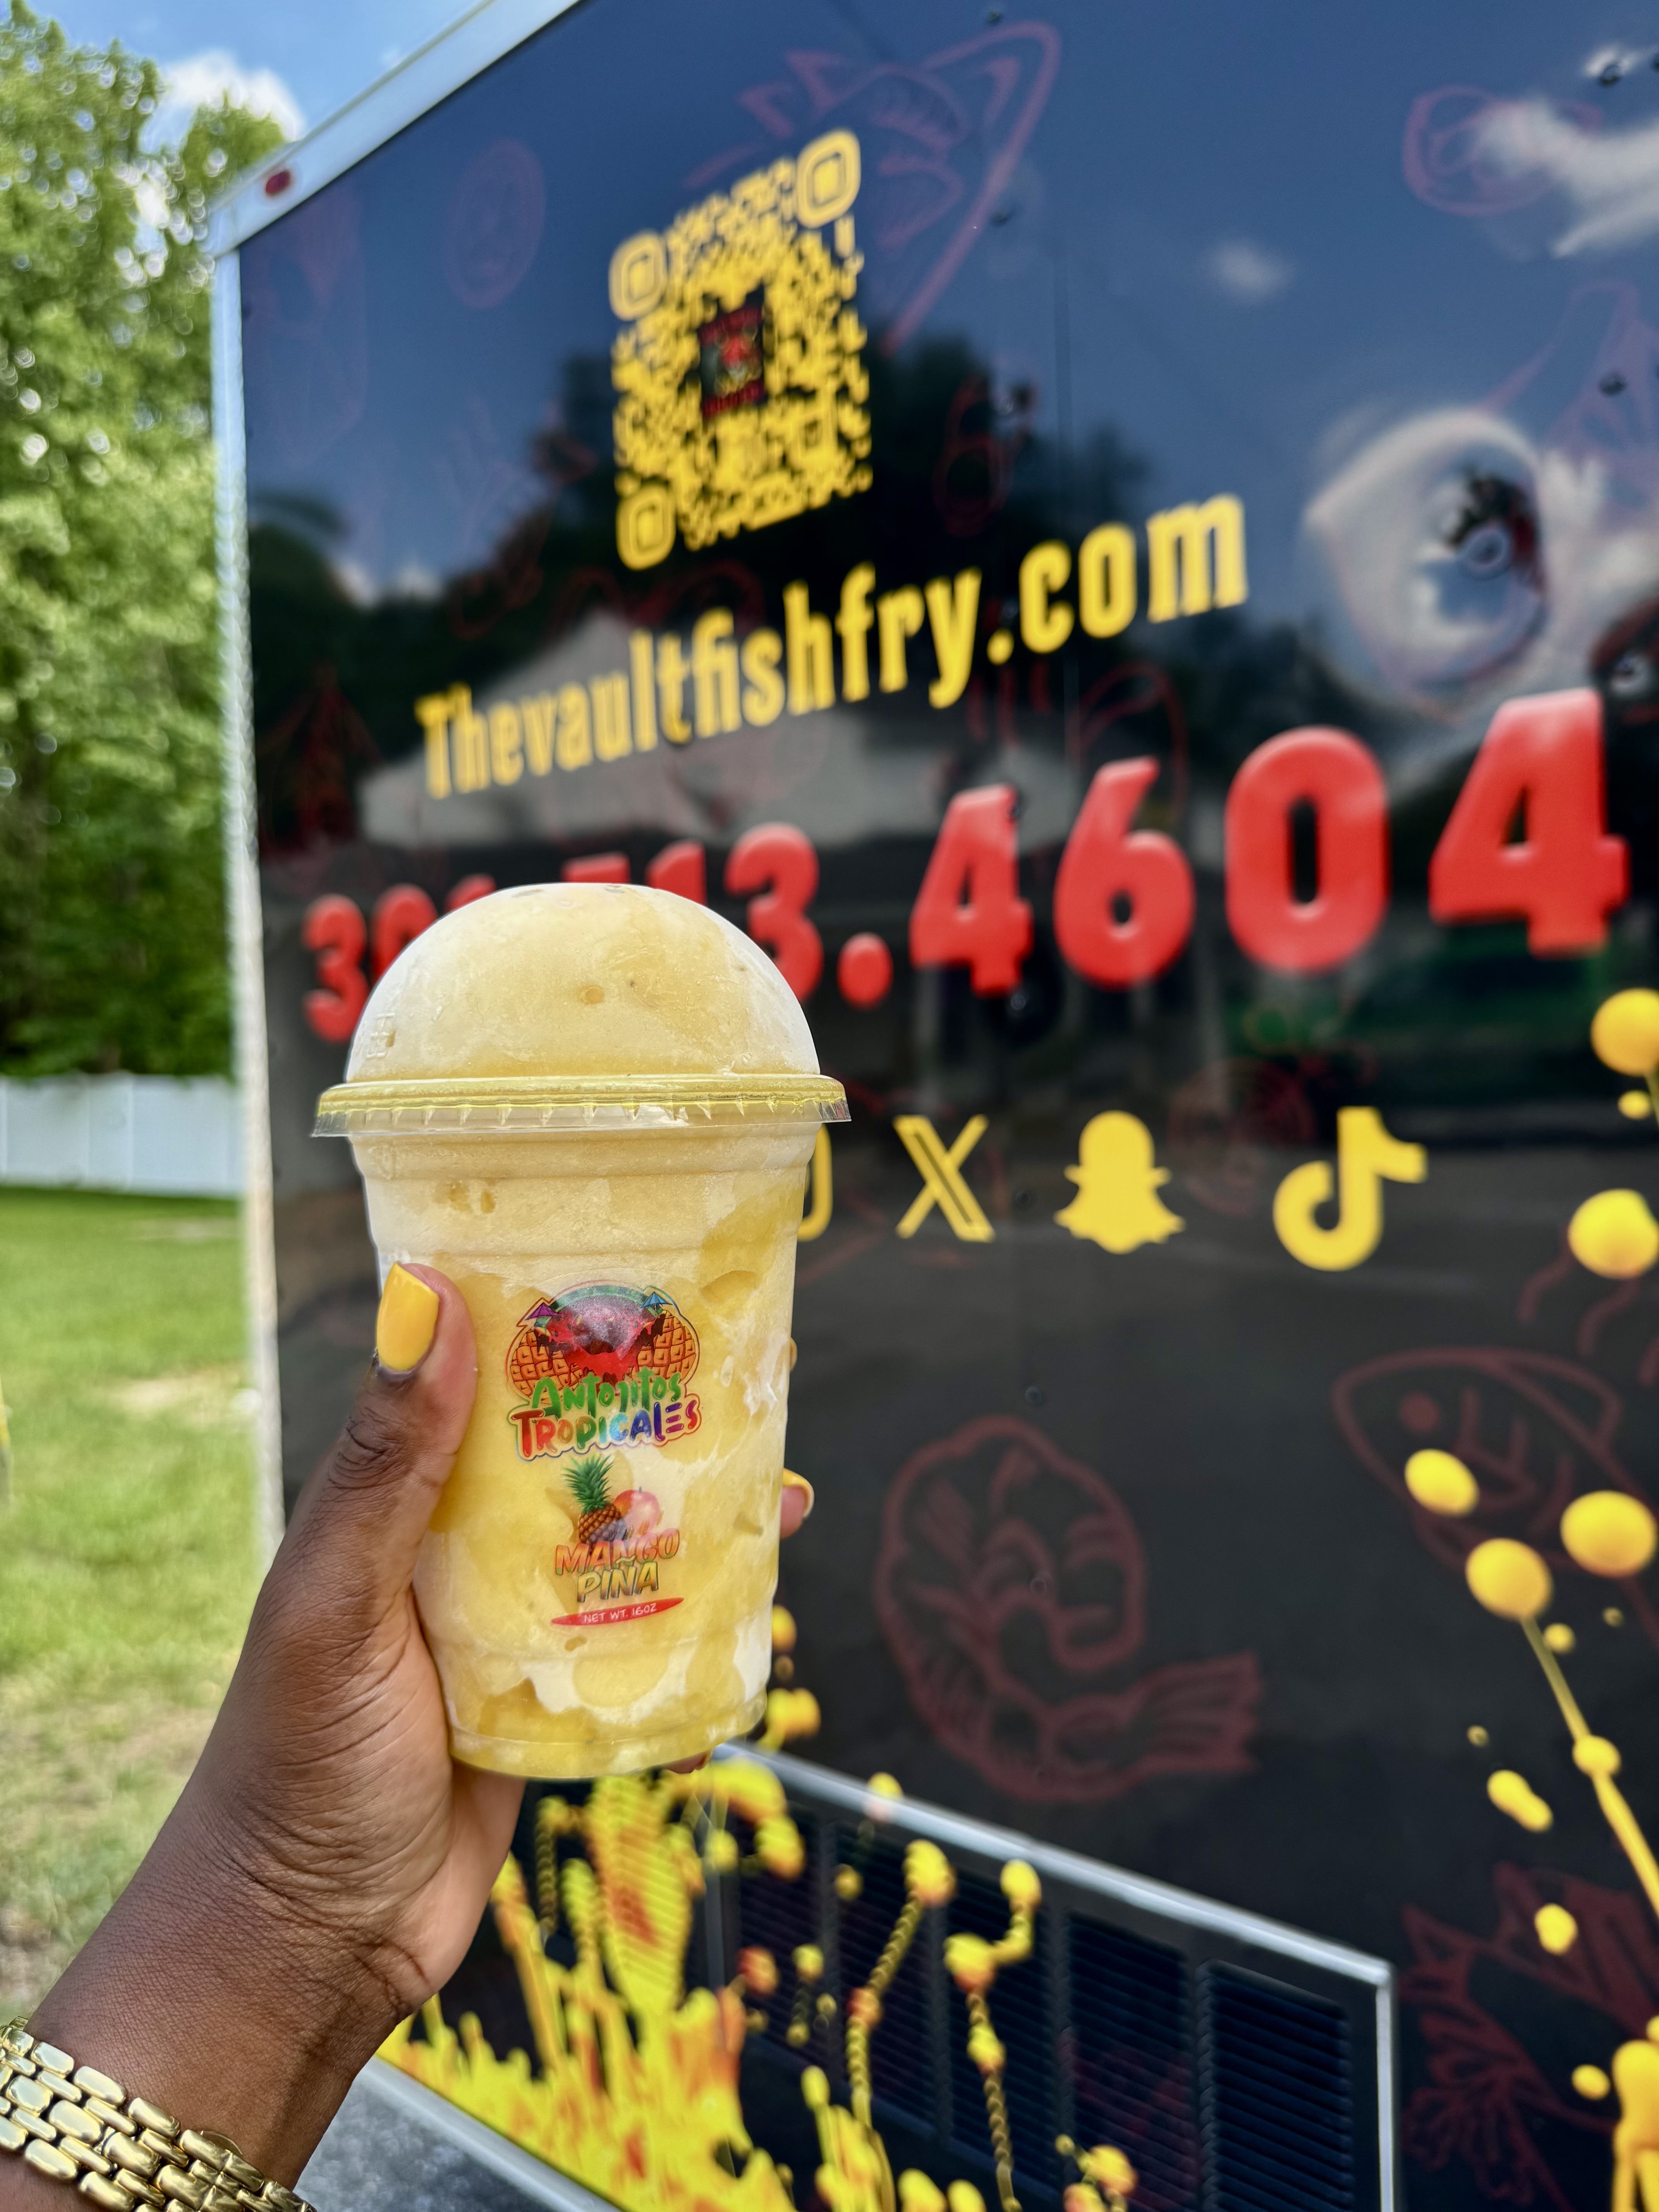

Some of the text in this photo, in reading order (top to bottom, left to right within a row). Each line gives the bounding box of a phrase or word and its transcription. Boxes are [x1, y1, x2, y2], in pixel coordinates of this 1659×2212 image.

[416, 496, 1248, 799] Thevaultfishfry.com
[511, 1399, 698, 1458] TROPICALES
[555, 1528, 680, 1575] MANGO
[577, 1554, 659, 1602] PIÑA
[583, 1613, 605, 1623] NET
[610, 1609, 628, 1620] WT.
